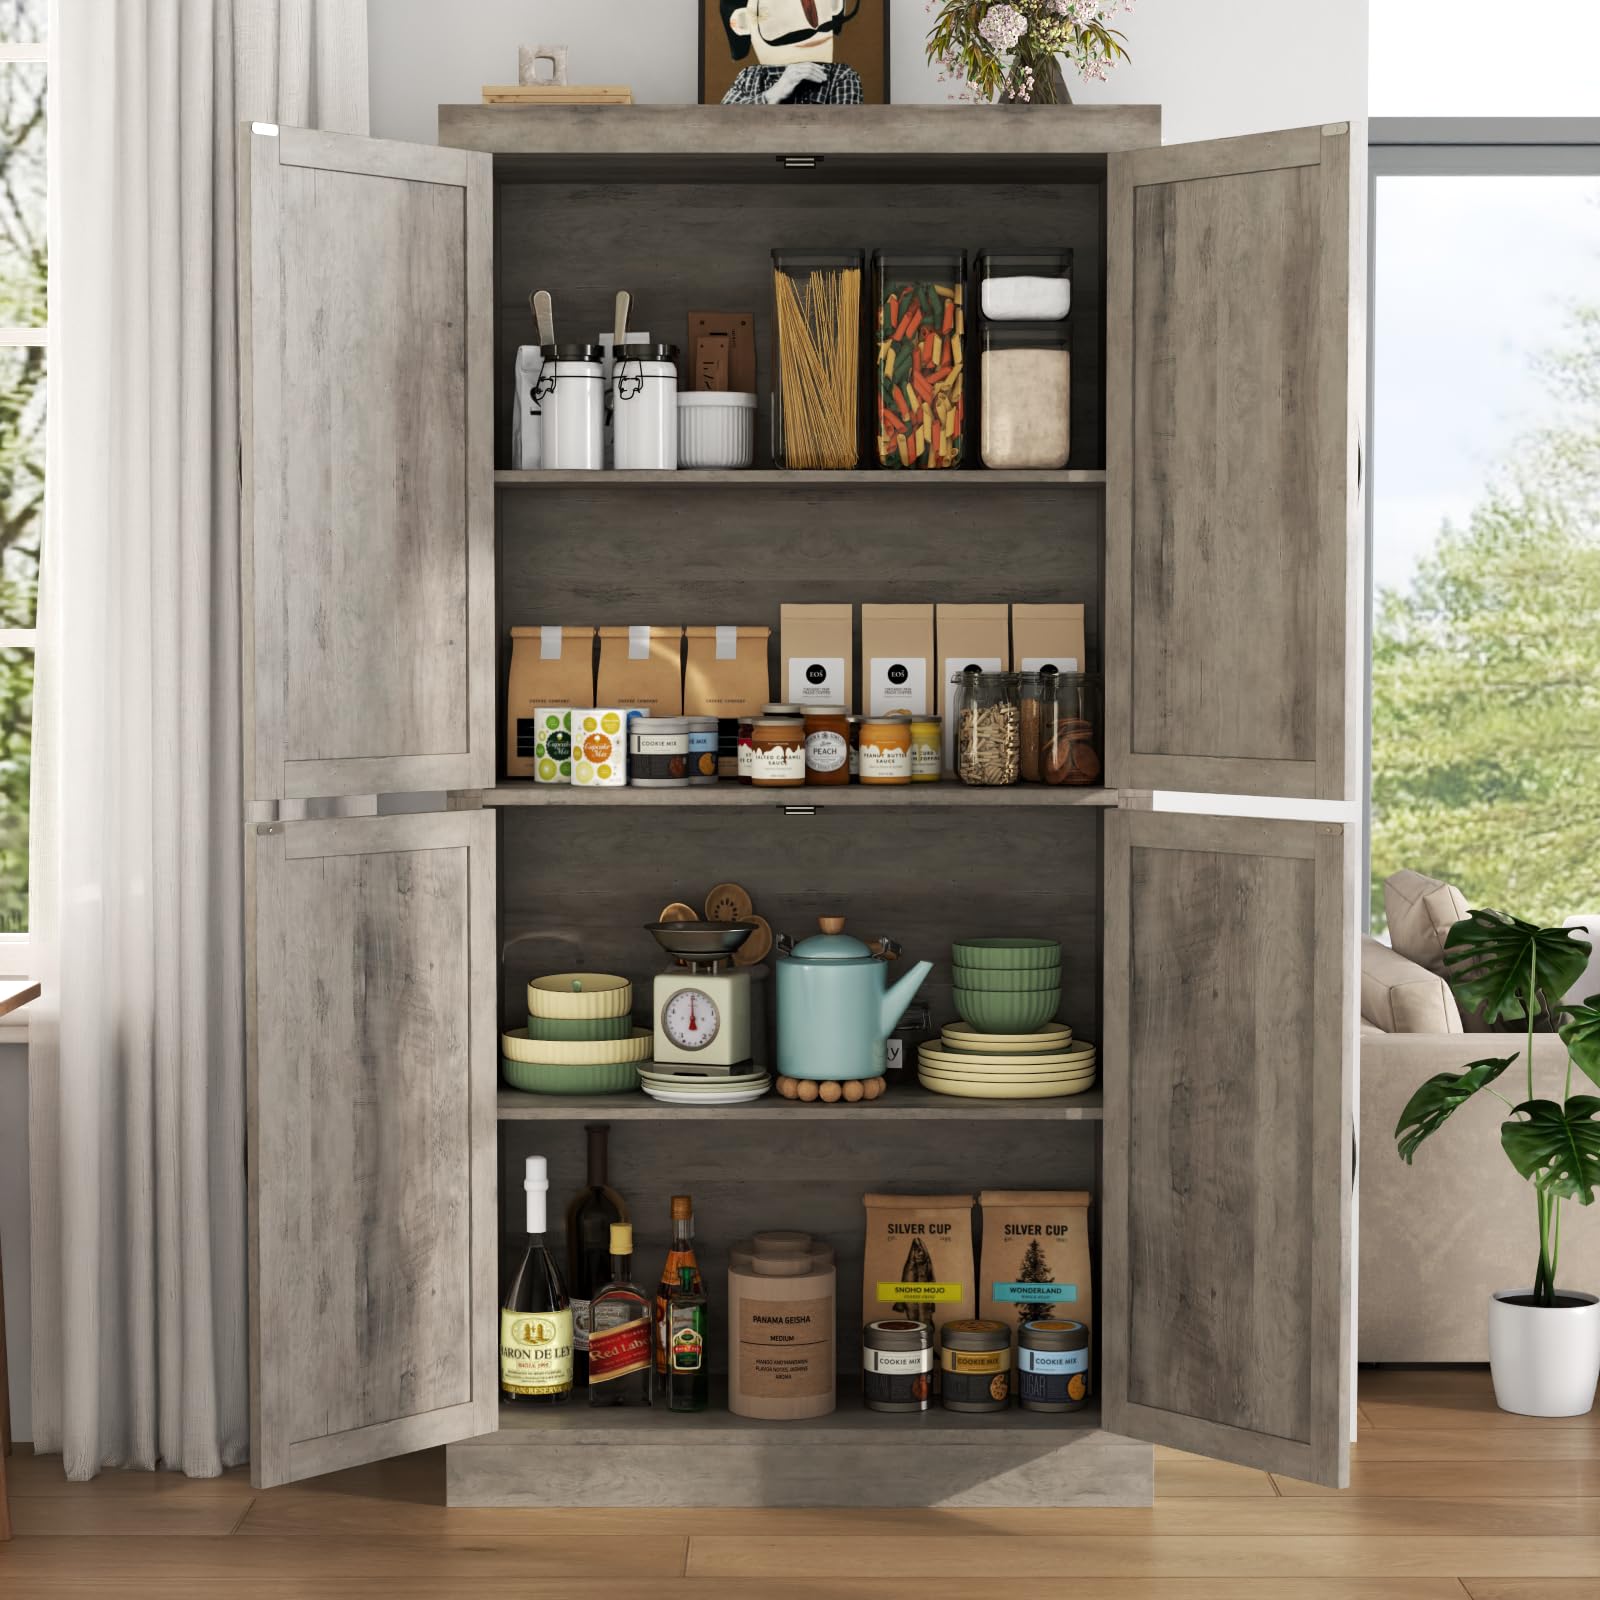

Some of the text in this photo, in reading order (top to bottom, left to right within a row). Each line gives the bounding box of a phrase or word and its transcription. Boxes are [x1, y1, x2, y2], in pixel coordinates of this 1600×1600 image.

[813, 747, 837, 755] PEACH
[887, 1223, 952, 1235] SILVER CUP
[1004, 1224, 1069, 1236] SILVER CUP
[895, 1286, 945, 1294] SNOHO MOJO
[752, 1315, 811, 1325] PANAMA GEISHA
[534, 1348, 553, 1360] DE
[589, 1345, 621, 1362] Red
[879, 1358, 908, 1366] COOKIE
[957, 1358, 985, 1366] COOKIE
[1035, 1358, 1063, 1366] COOKIE
